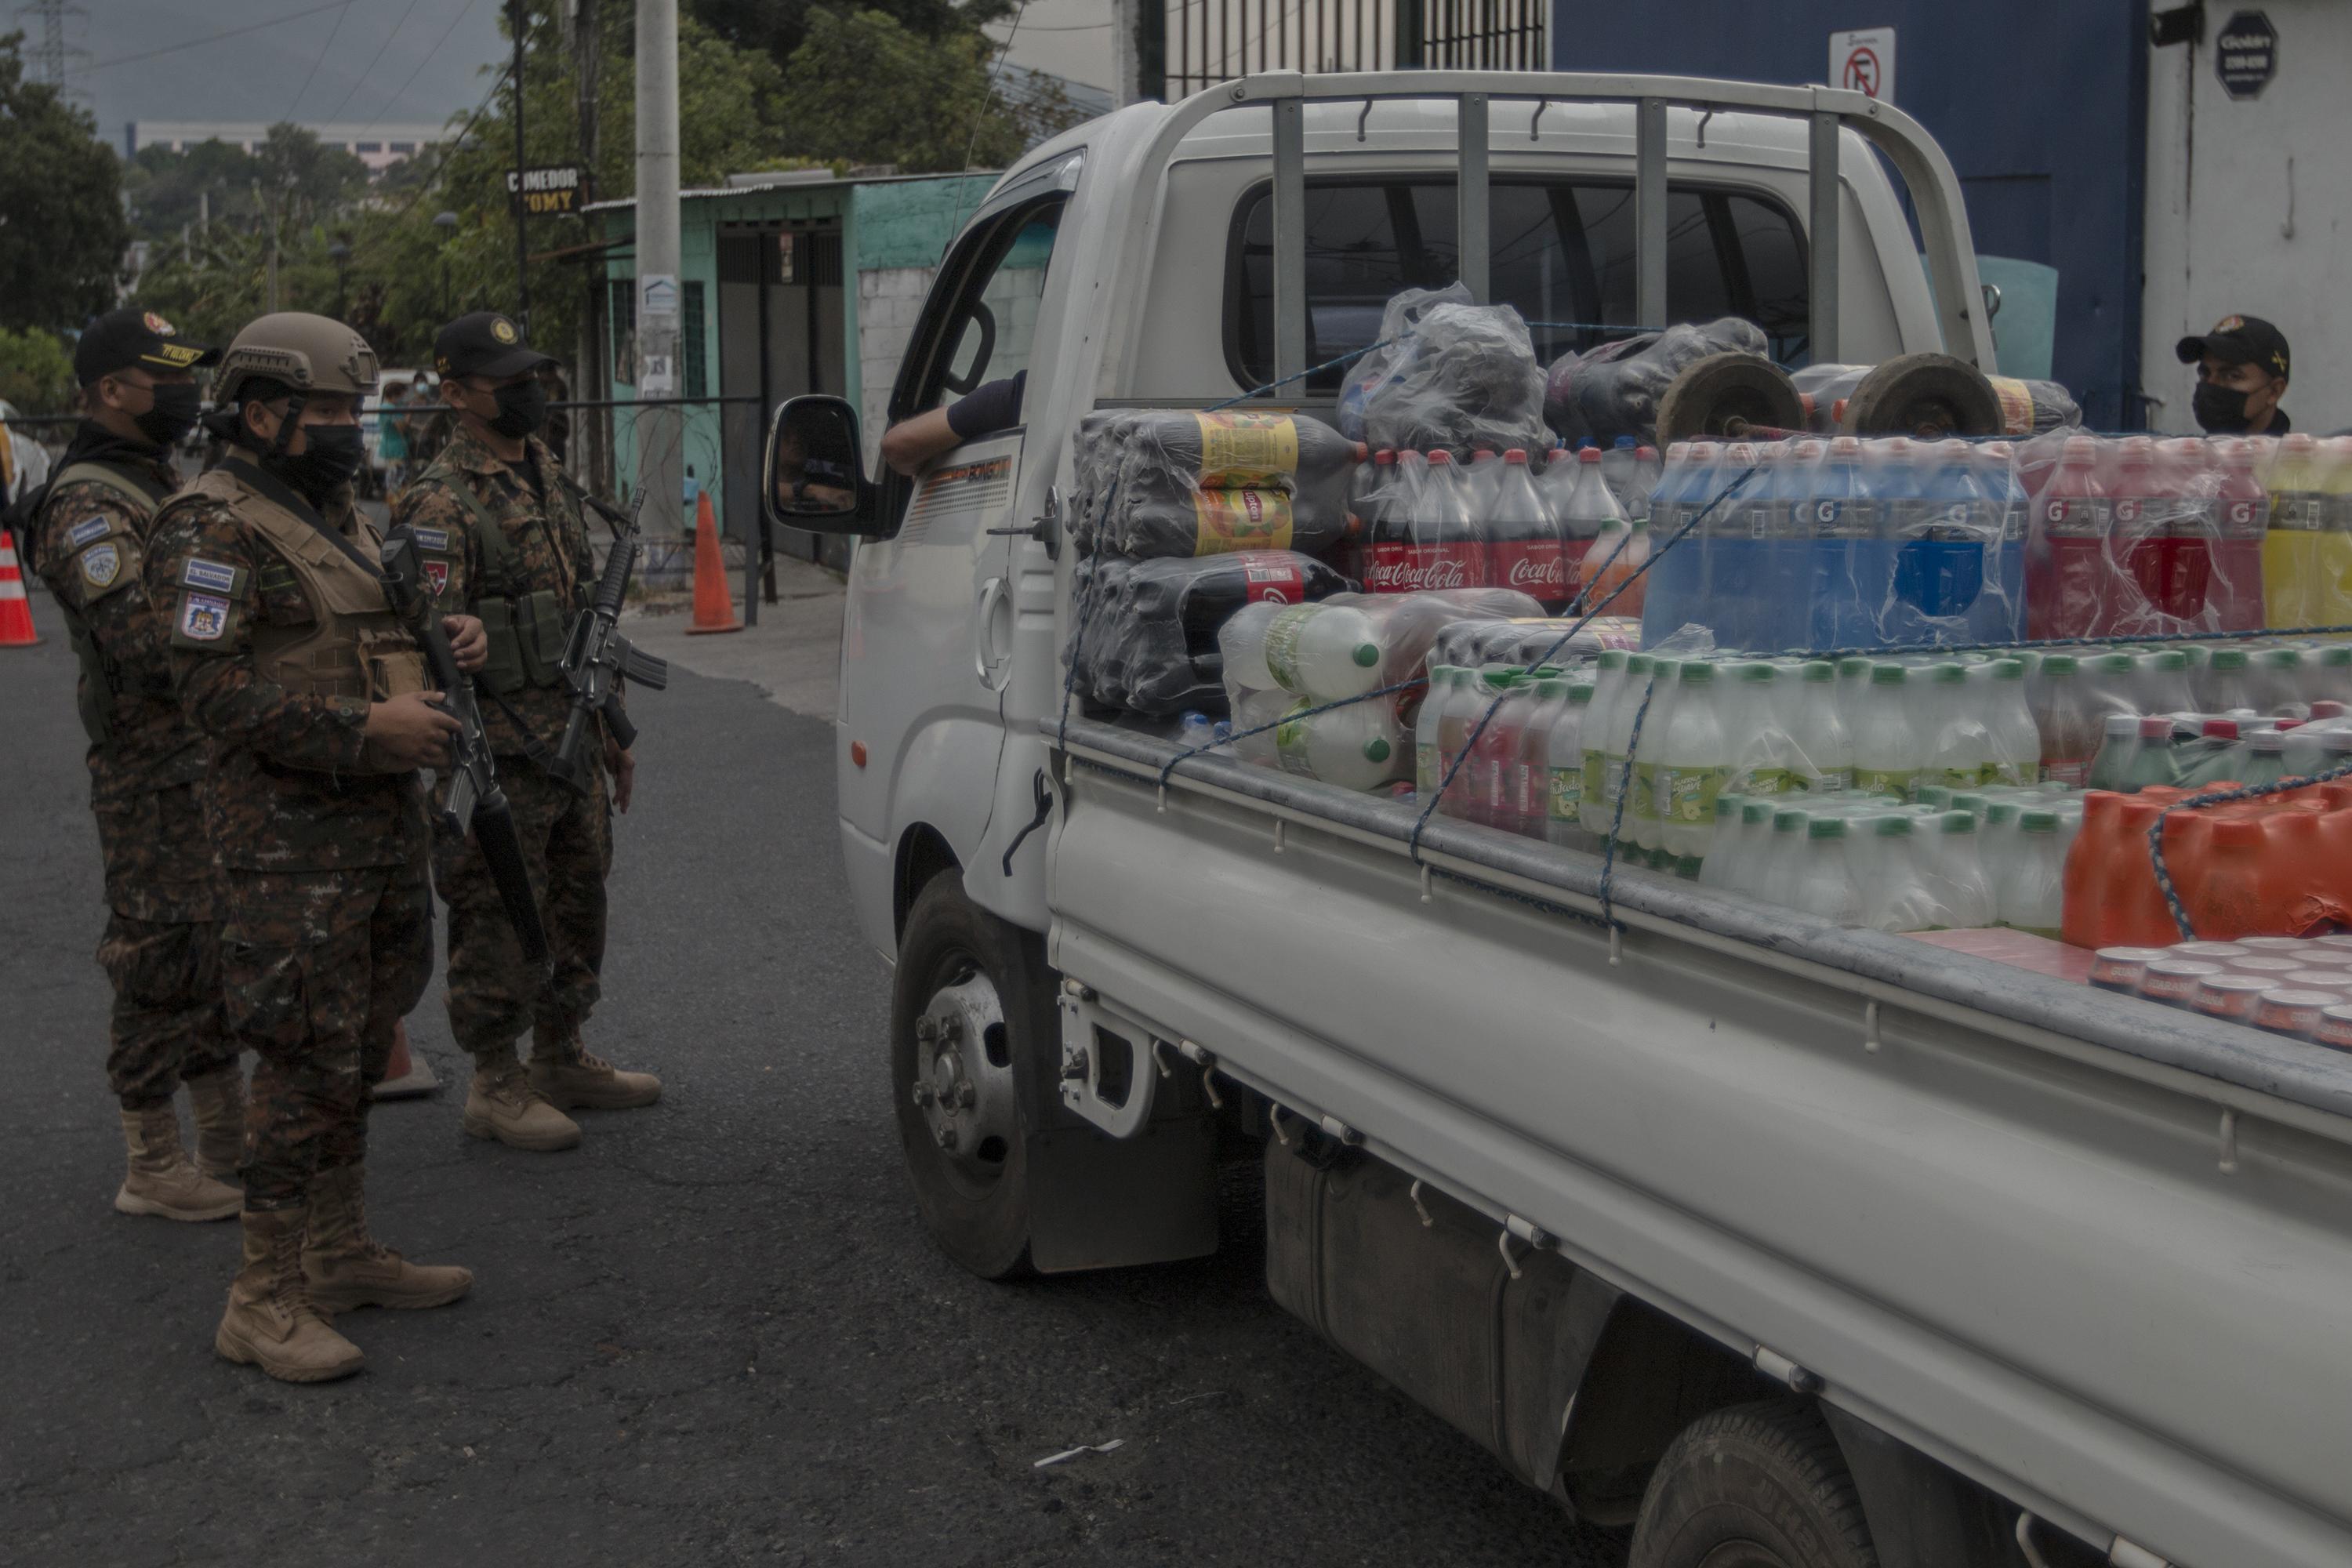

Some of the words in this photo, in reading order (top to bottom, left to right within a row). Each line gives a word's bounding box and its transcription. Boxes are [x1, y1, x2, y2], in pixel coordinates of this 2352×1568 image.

[1817, 501, 1835, 523] G
[2048, 501, 2063, 522] G
[2115, 500, 2134, 521] G
[2230, 503, 2249, 523] G
